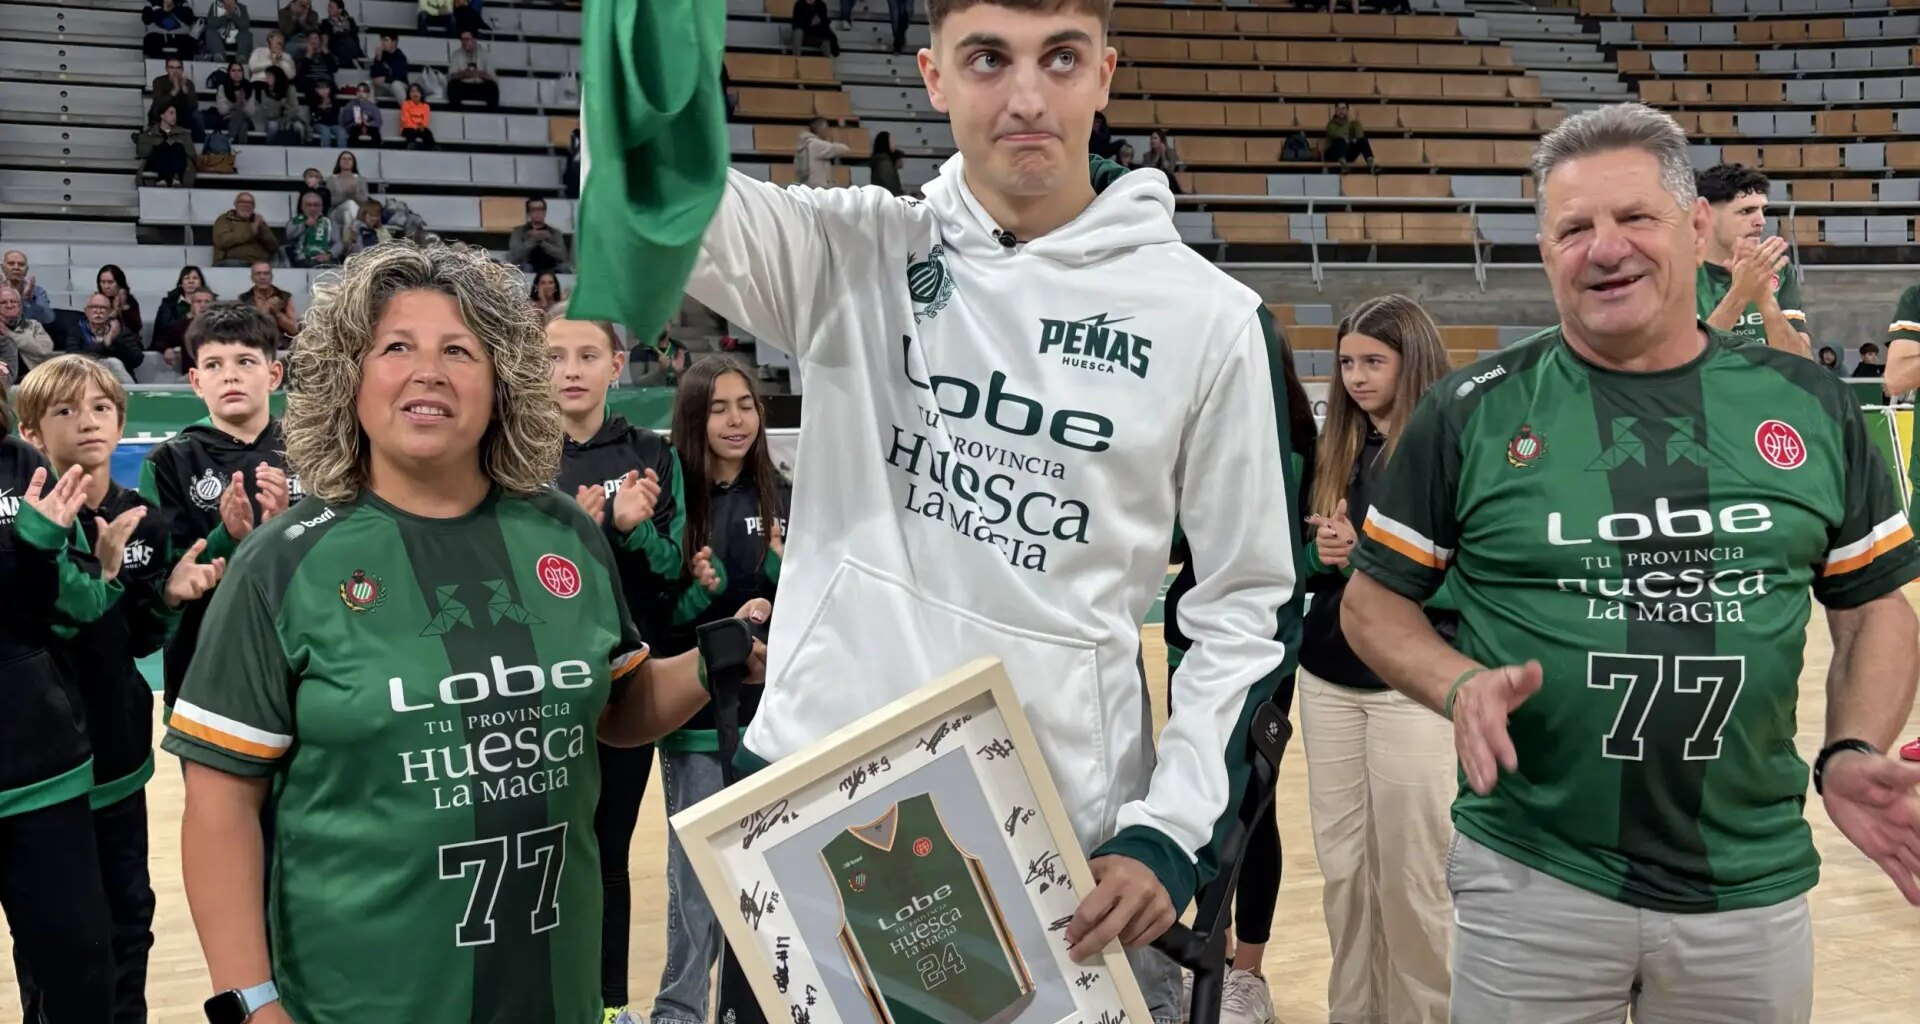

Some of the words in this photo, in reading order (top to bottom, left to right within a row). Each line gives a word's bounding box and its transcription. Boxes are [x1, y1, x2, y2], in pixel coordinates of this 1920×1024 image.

[1062, 357, 1115, 374] HUESCA
[1472, 364, 1507, 383] barri
[902, 335, 1114, 453] Lobe
[300, 507, 336, 527] barri
[905, 483, 944, 521] La
[1548, 497, 1773, 546] Lobe
[1587, 599, 1627, 621] La
[388, 655, 593, 713] Lobe
[1587, 652, 1746, 761] 77
[398, 724, 584, 784] Huesca
[433, 784, 473, 810] La
[438, 822, 568, 947] 77
[878, 884, 952, 931] Lobe
[890, 907, 962, 955] Huesca
[916, 942, 967, 991] 24
